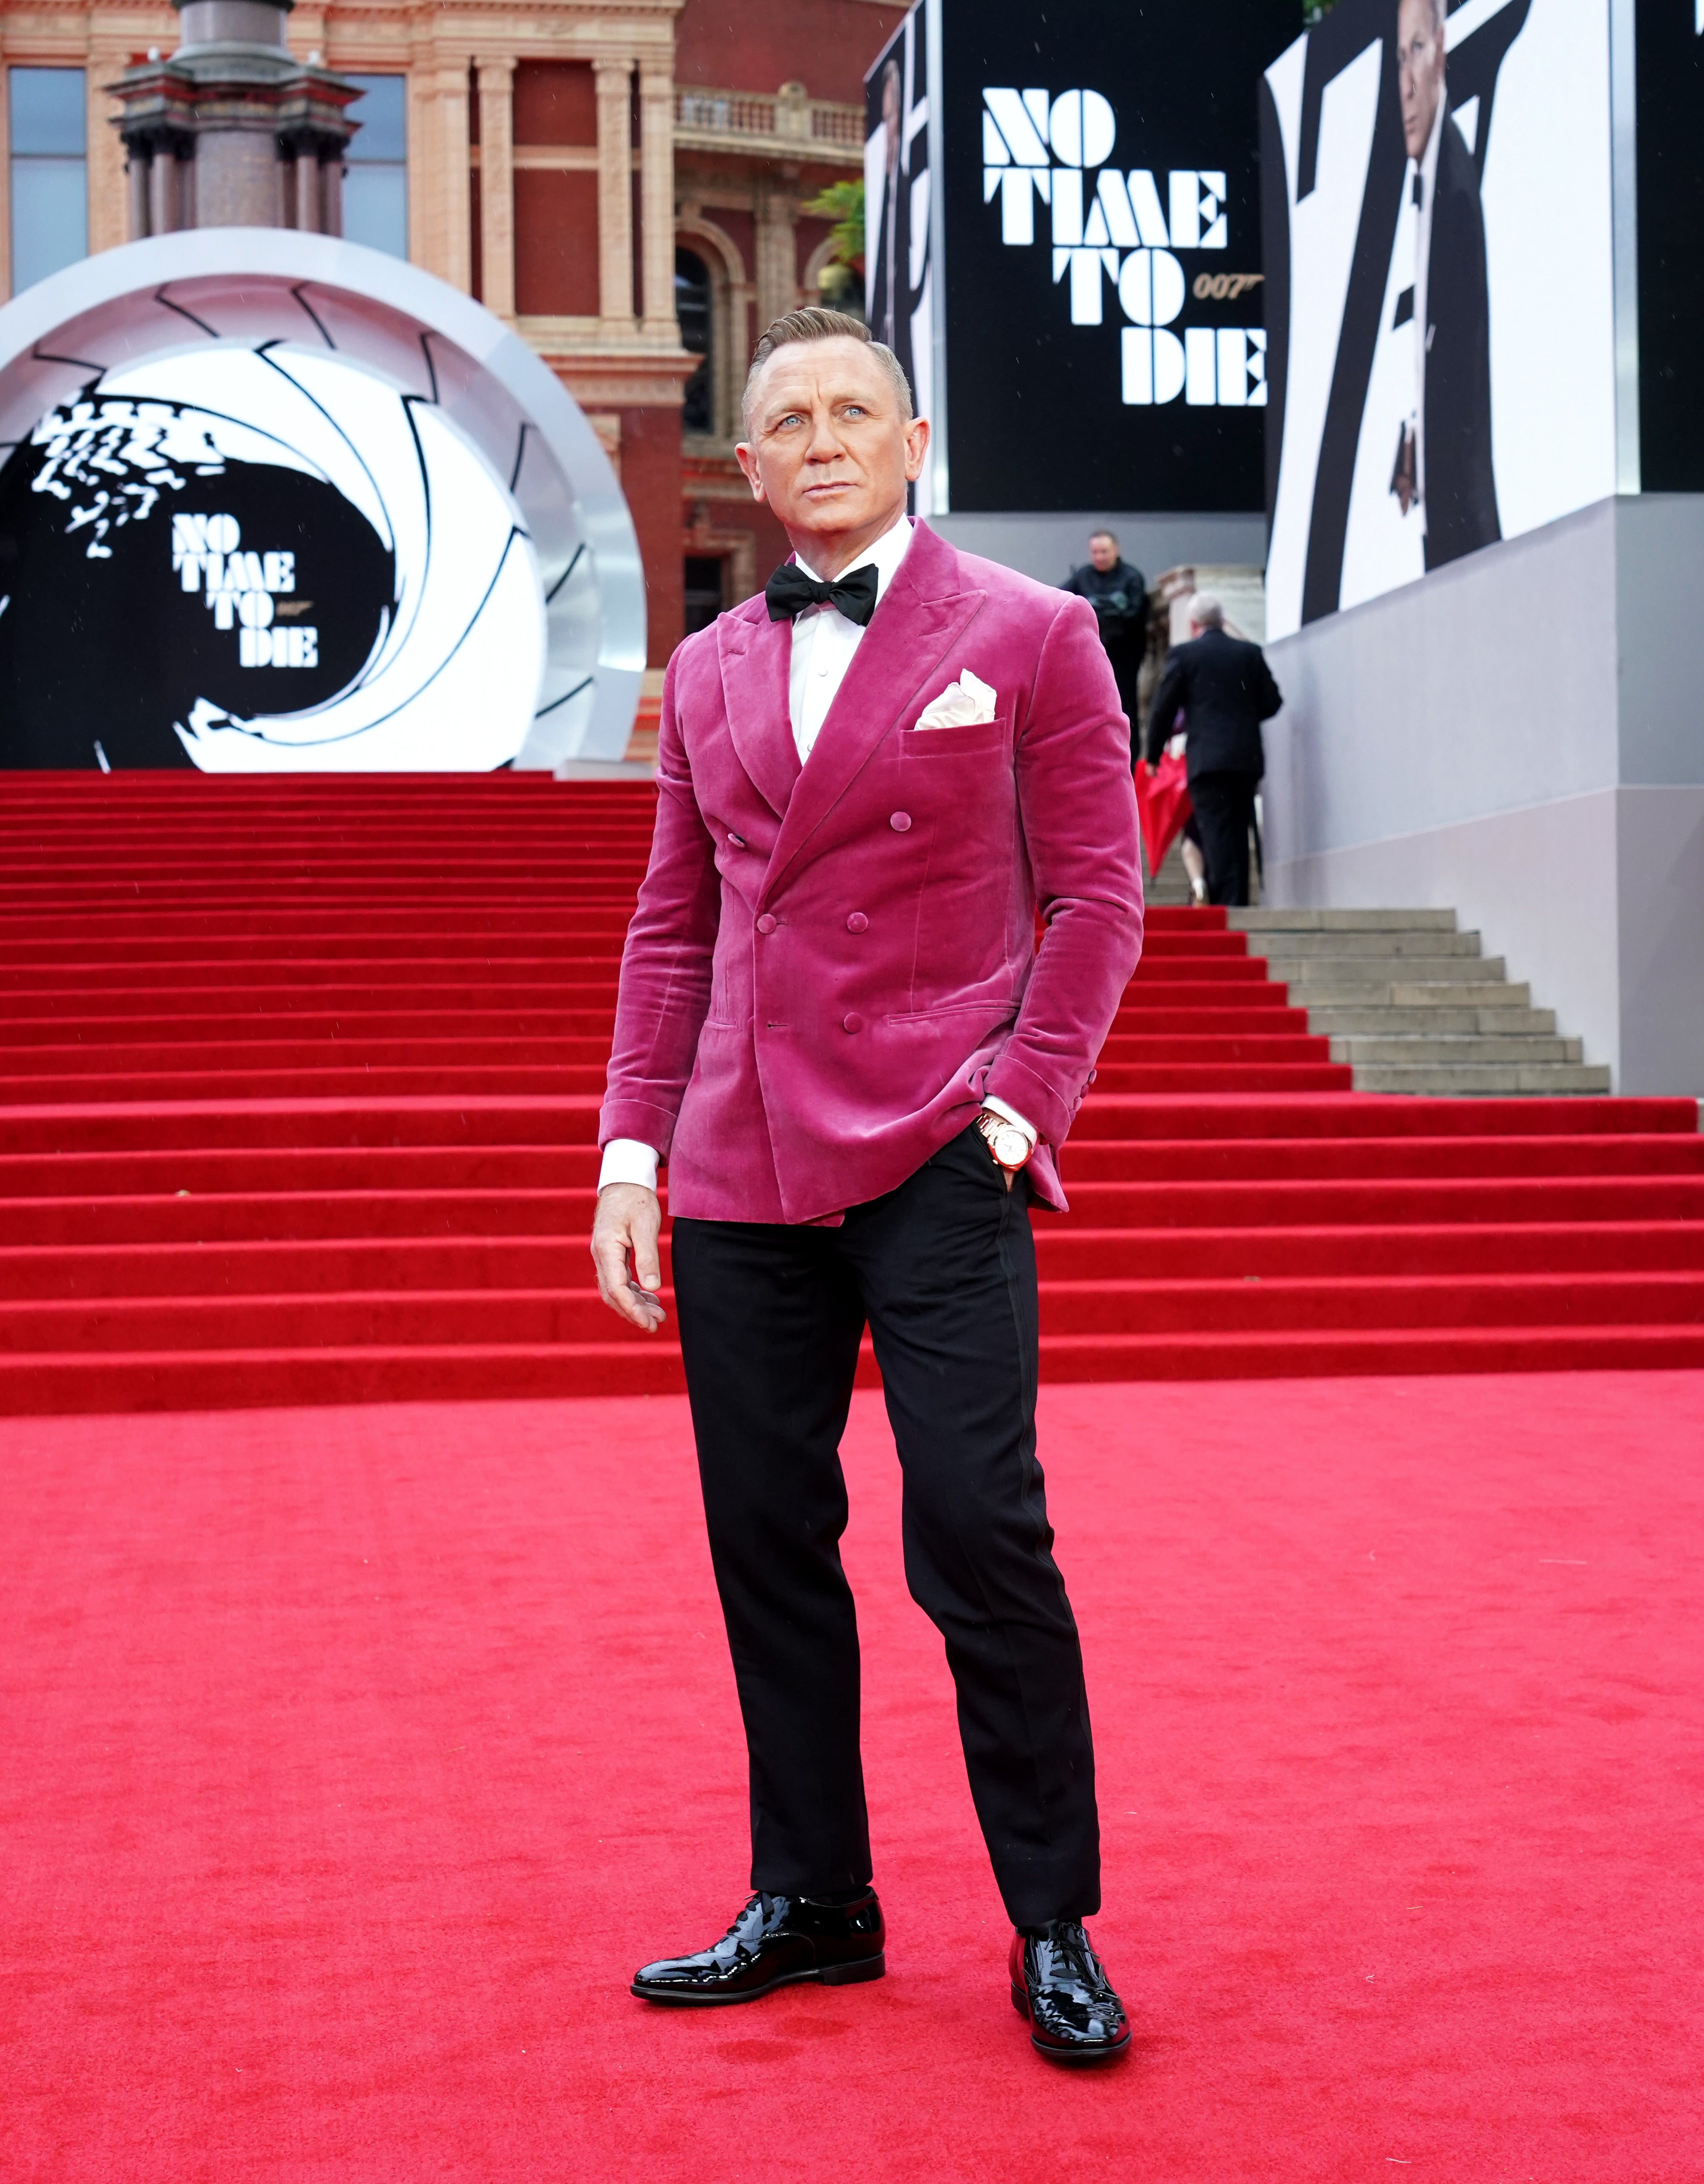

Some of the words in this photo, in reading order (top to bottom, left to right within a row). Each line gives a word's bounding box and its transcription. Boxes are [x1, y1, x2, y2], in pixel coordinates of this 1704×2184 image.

[982, 87, 1115, 168] NO
[983, 167, 1227, 249] TIME
[1052, 247, 1185, 326] TO
[1193, 273, 1256, 300] 007
[1121, 326, 1267, 406] DIE
[172, 513, 241, 554] NO
[172, 551, 295, 592] TIME
[205, 591, 274, 629] TO
[239, 626, 318, 668] DIE
